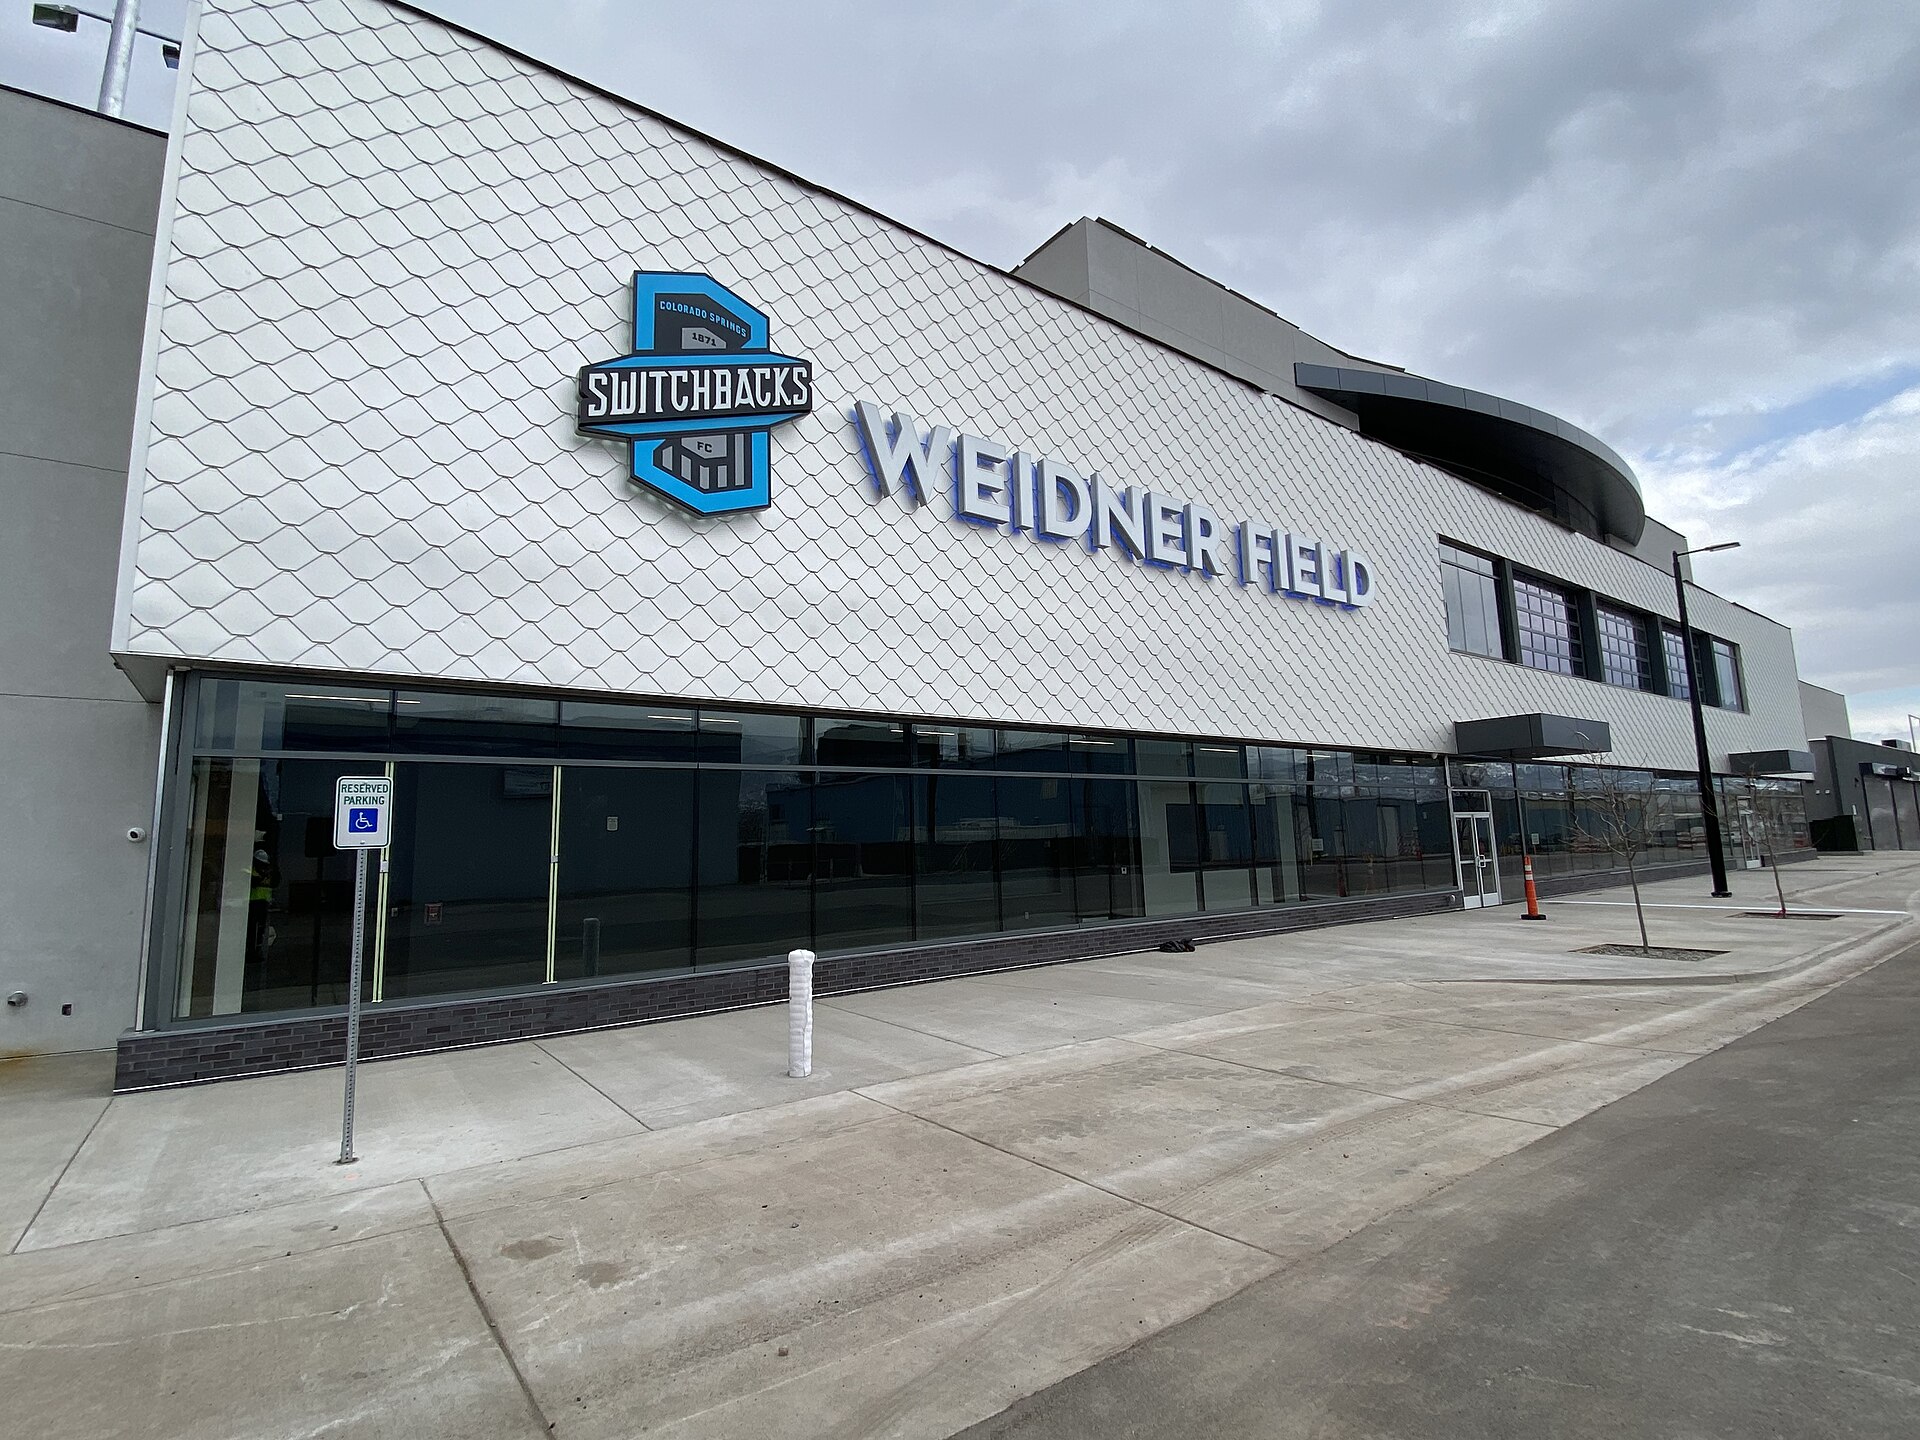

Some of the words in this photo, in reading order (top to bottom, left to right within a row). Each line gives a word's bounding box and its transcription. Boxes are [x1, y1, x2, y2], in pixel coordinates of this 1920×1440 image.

[660, 300, 708, 319] COLORADO
[709, 312, 747, 338] SPRINGS
[691, 332, 717, 347] 1871
[588, 367, 808, 416] SWITCHBACKS
[696, 441, 713, 453] FC
[854, 400, 1224, 576] WEIDNER
[1238, 520, 1376, 608] FIELD
[341, 784, 388, 793] RESERVED
[343, 796, 385, 805] PARKING
